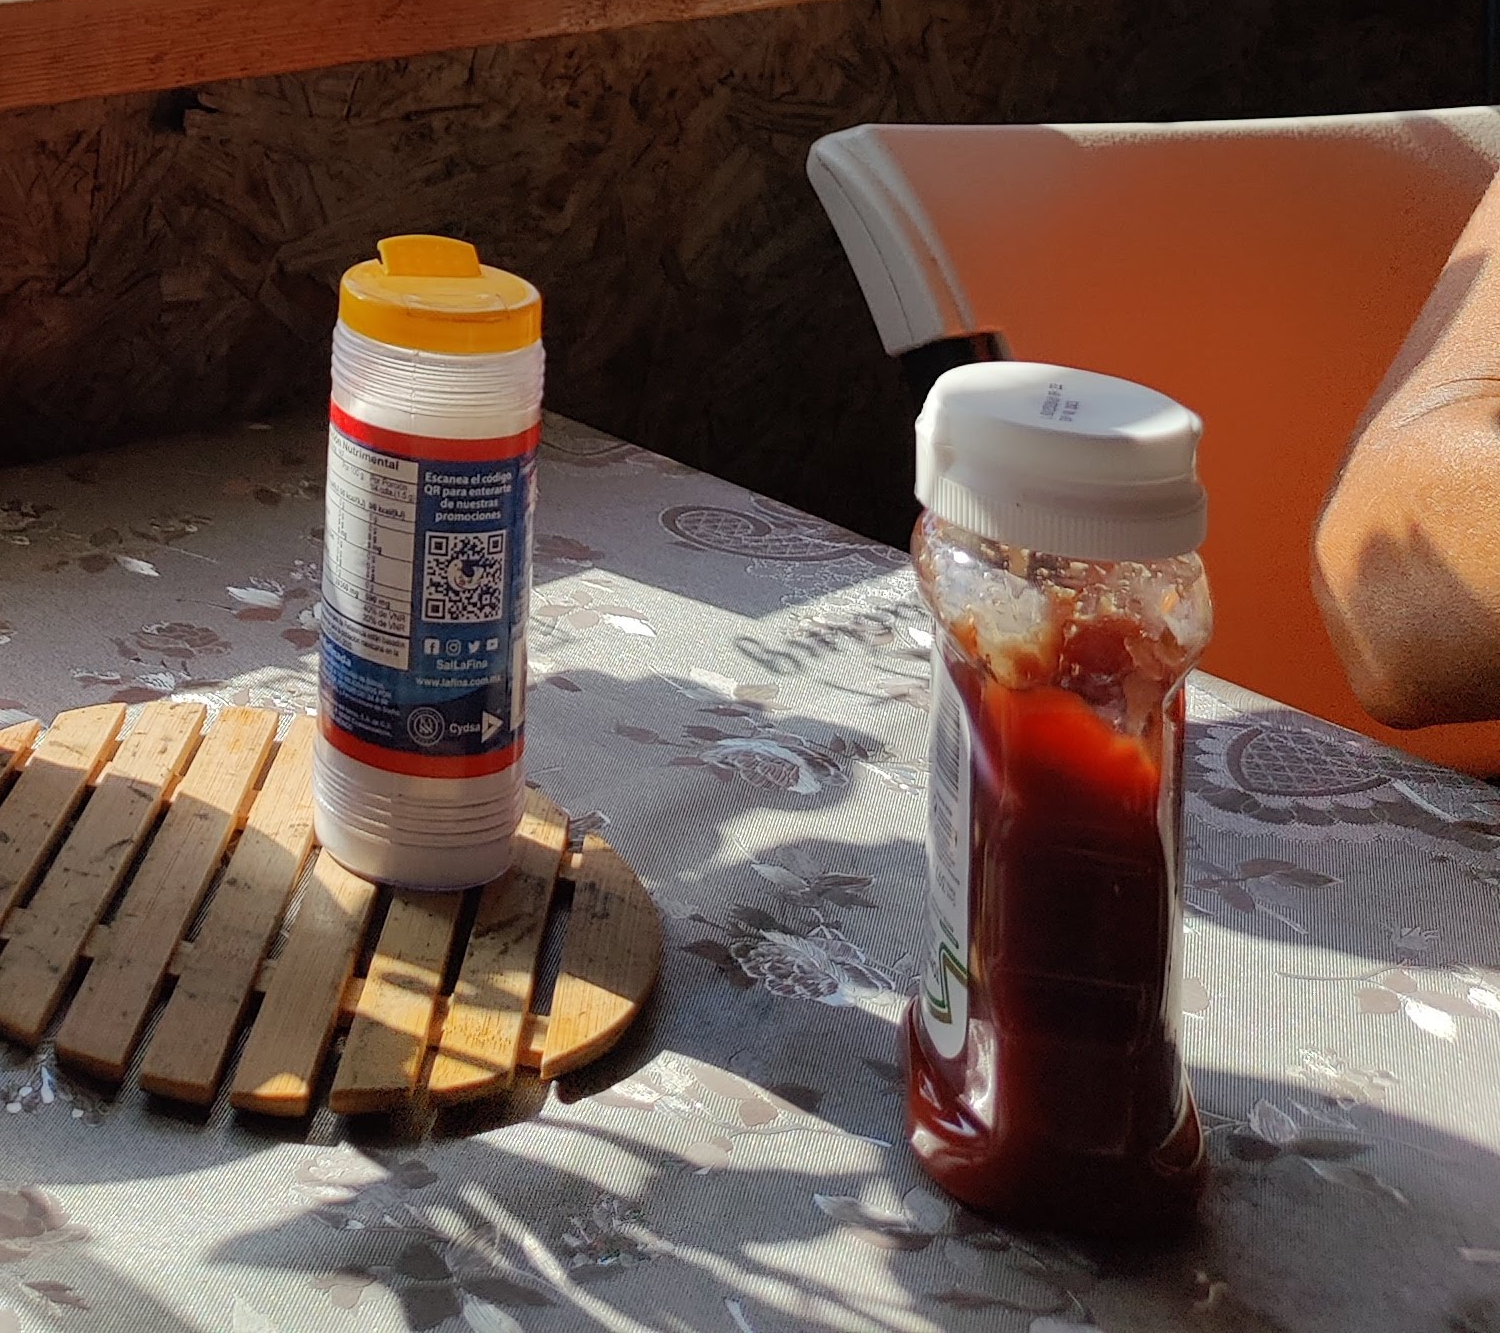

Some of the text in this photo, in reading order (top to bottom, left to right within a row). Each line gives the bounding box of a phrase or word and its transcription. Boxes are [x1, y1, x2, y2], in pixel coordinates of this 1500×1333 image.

[341, 440, 400, 472] Nutrimental
[424, 470, 513, 486] Escanea el código
[423, 483, 513, 498] QR para enterarte
[440, 498, 499, 509] de nuestras
[435, 510, 502, 523] promociones
[449, 722, 481, 737] Cydsa
